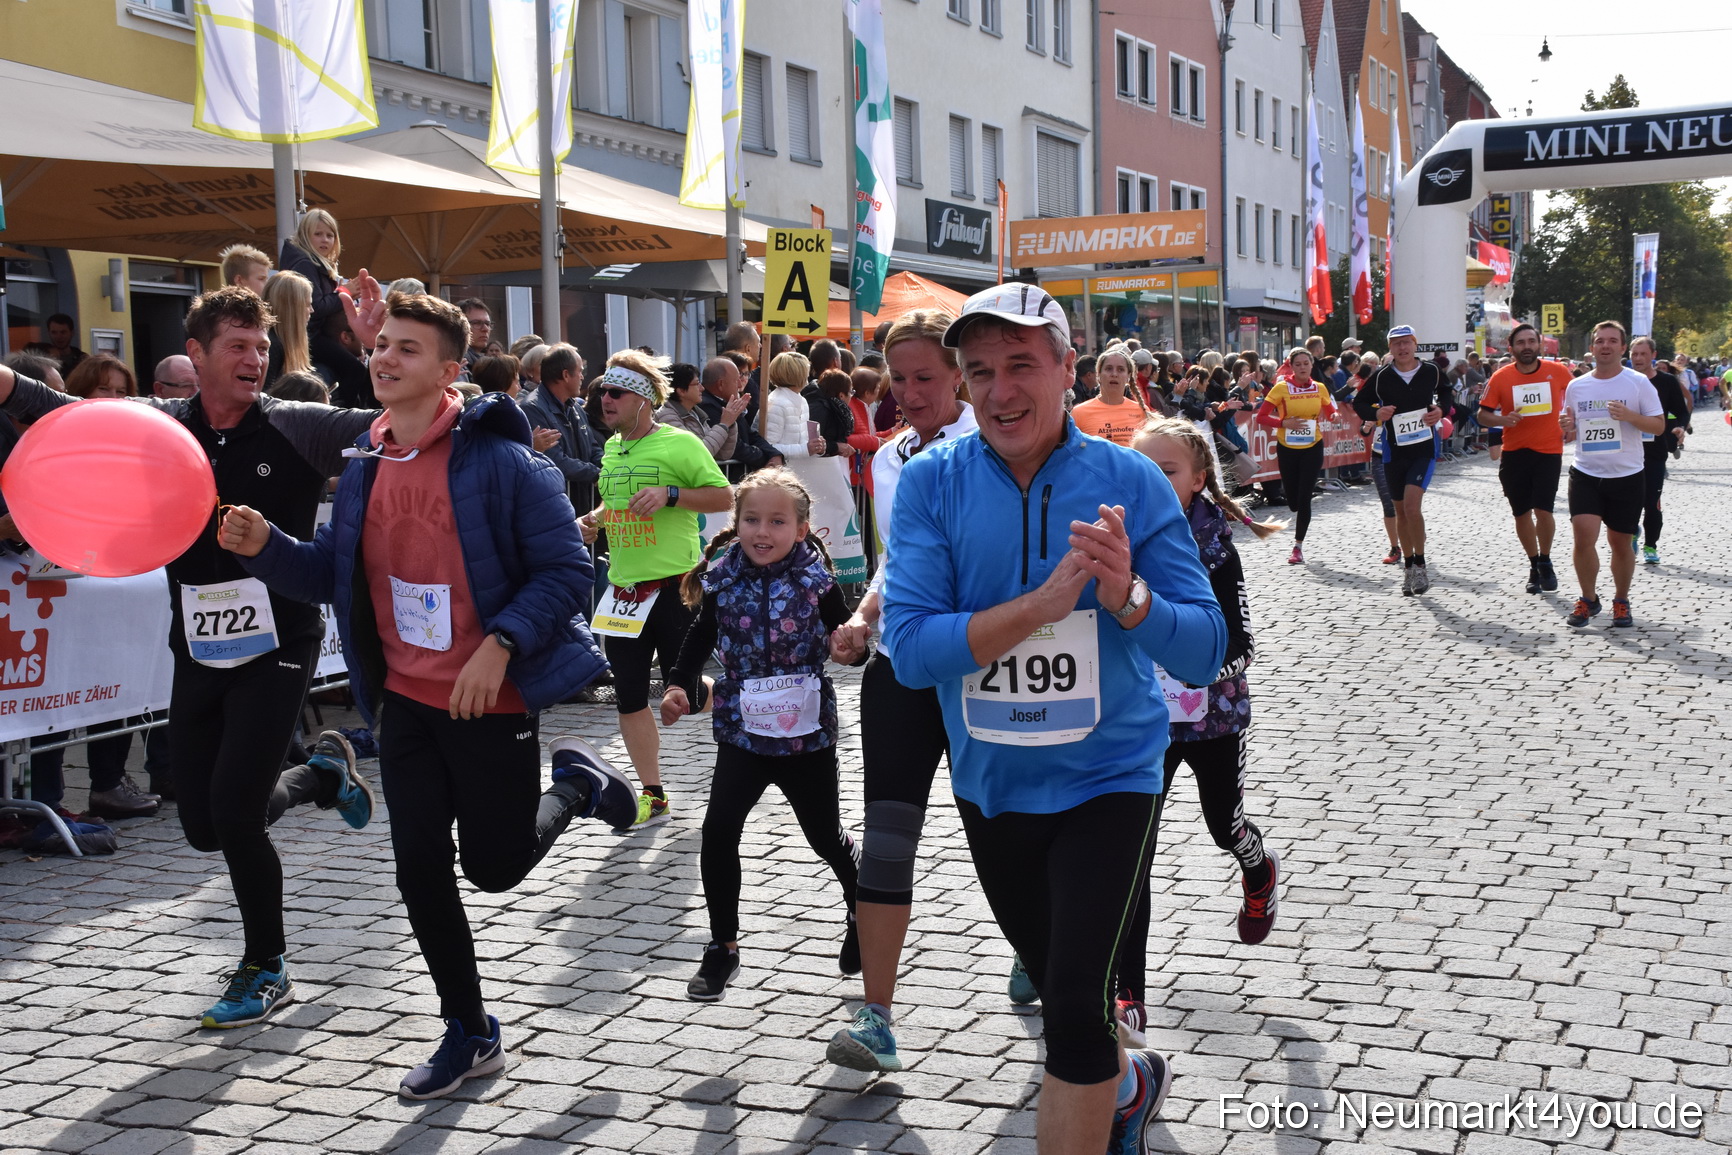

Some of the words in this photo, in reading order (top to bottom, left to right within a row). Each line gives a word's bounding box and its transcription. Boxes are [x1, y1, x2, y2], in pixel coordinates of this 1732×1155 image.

[1524, 123, 1631, 161] MINI
[775, 232, 825, 252] Block
[1017, 224, 1197, 256] RUNMARKT.DE
[777, 261, 814, 312] A
[1097, 277, 1165, 290] RUNMARKT.DE
[1547, 313, 1558, 328] B
[1690, 343, 1697, 352] C
[1522, 393, 1541, 404] 401
[1399, 419, 1425, 433] 2174
[1585, 428, 1615, 441] 2759
[207, 588, 240, 600] BOCK
[611, 600, 640, 617] 132
[193, 605, 260, 636] 2722
[607, 619, 630, 629] Andreas
[0, 654, 42, 685] MS
[980, 653, 1077, 694] 2199
[750, 677, 793, 692] 2000
[22, 690, 81, 712] EINZELNE
[85, 684, 121, 703] ZÄHLT
[743, 701, 800, 713] Victoria
[1009, 707, 1047, 722] Josef
